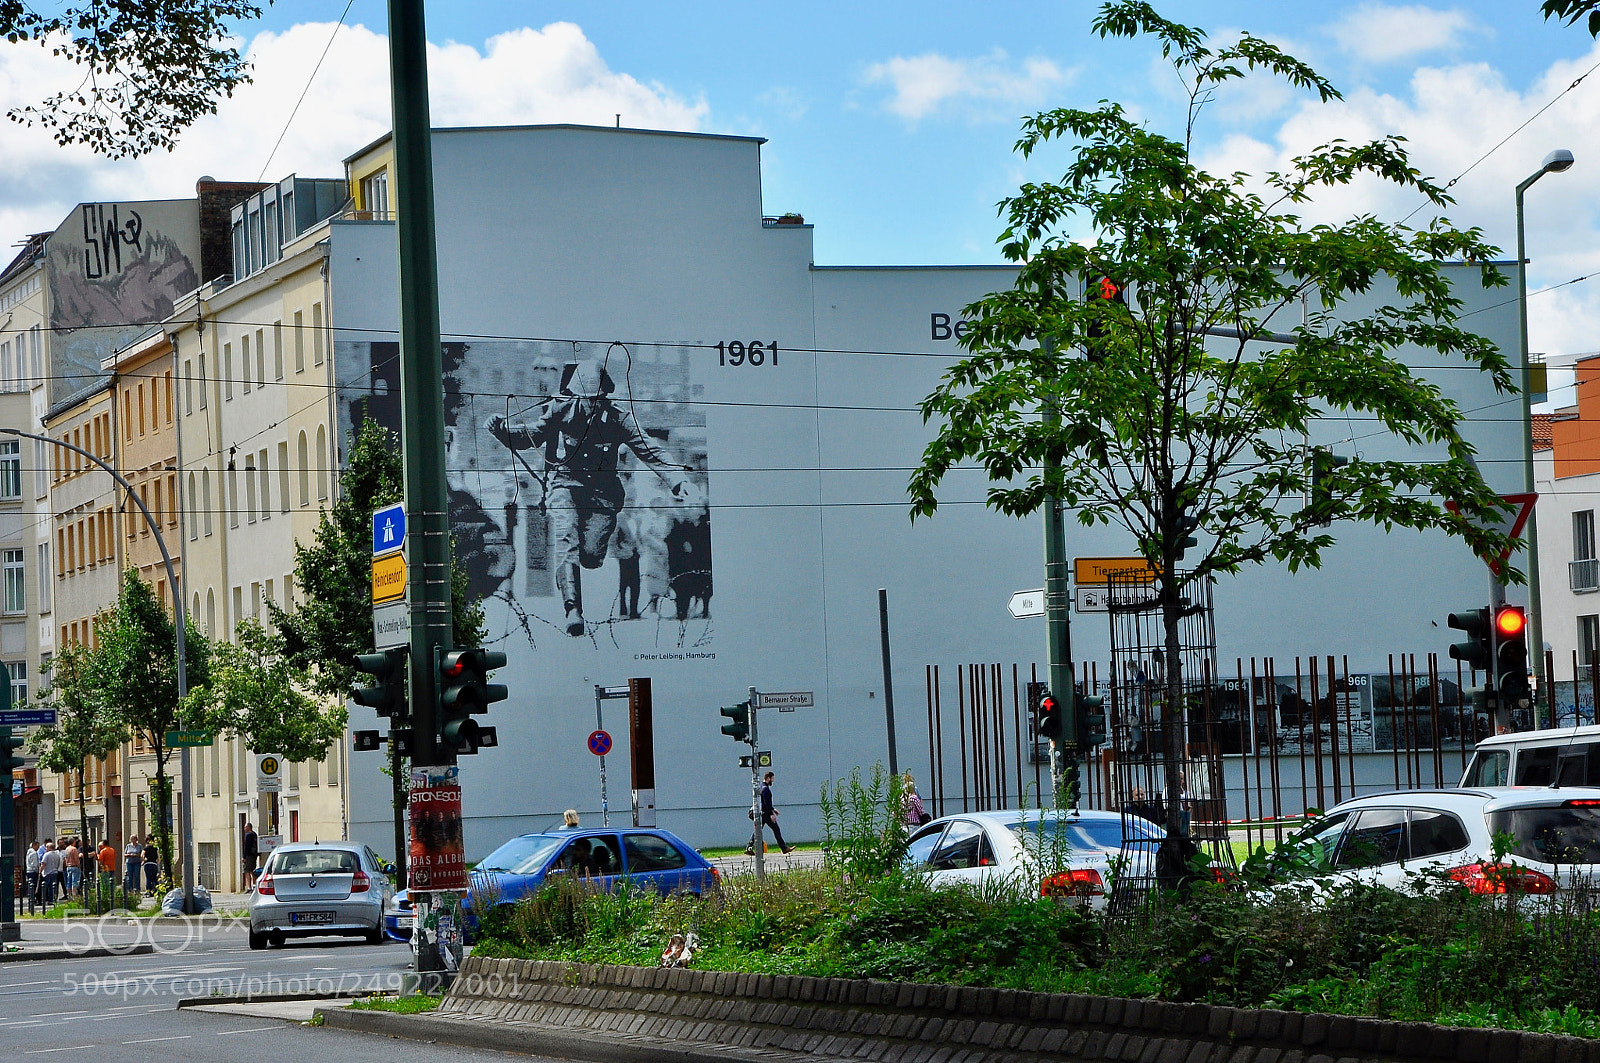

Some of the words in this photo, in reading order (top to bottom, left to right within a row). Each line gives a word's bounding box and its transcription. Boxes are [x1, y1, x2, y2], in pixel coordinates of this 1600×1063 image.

[714, 340, 778, 366] 1961
[374, 566, 403, 588] Reinickendorf
[1092, 565, 1145, 579] Tiergarten
[1022, 599, 1033, 609] Mitte
[659, 652, 685, 661] Leibing,
[686, 651, 716, 660] Hamburg
[1096, 681, 1112, 690] End
[1224, 681, 1248, 691] 1964
[1345, 676, 1367, 686] 966
[764, 696, 789, 704] Bernauer
[789, 694, 808, 704] Straße
[413, 855, 431, 866] DAS
